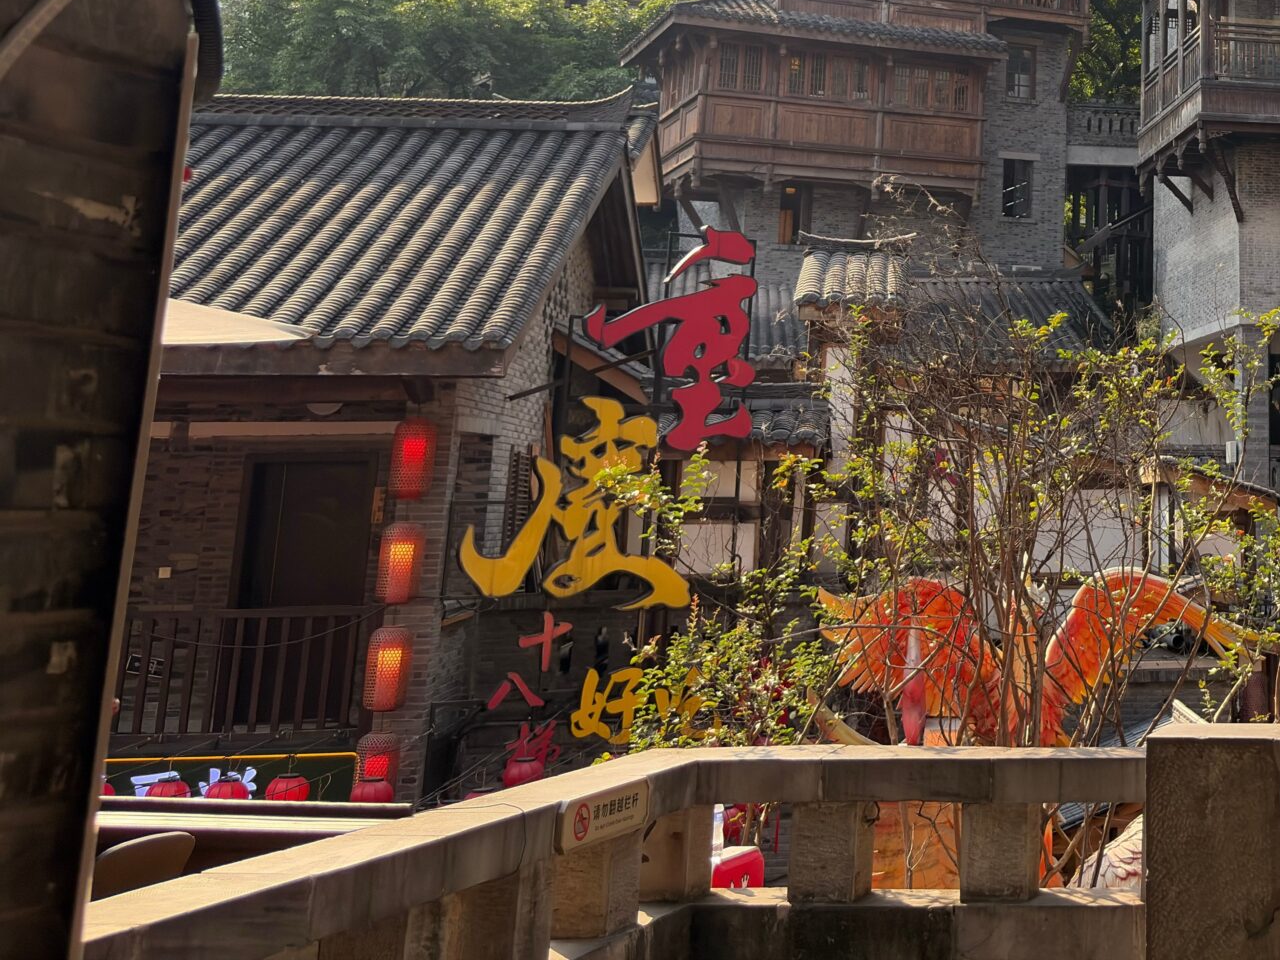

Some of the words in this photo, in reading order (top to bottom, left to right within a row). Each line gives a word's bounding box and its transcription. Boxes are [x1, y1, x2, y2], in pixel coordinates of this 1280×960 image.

[593, 792, 639, 821] 请勿翻越栏杆
